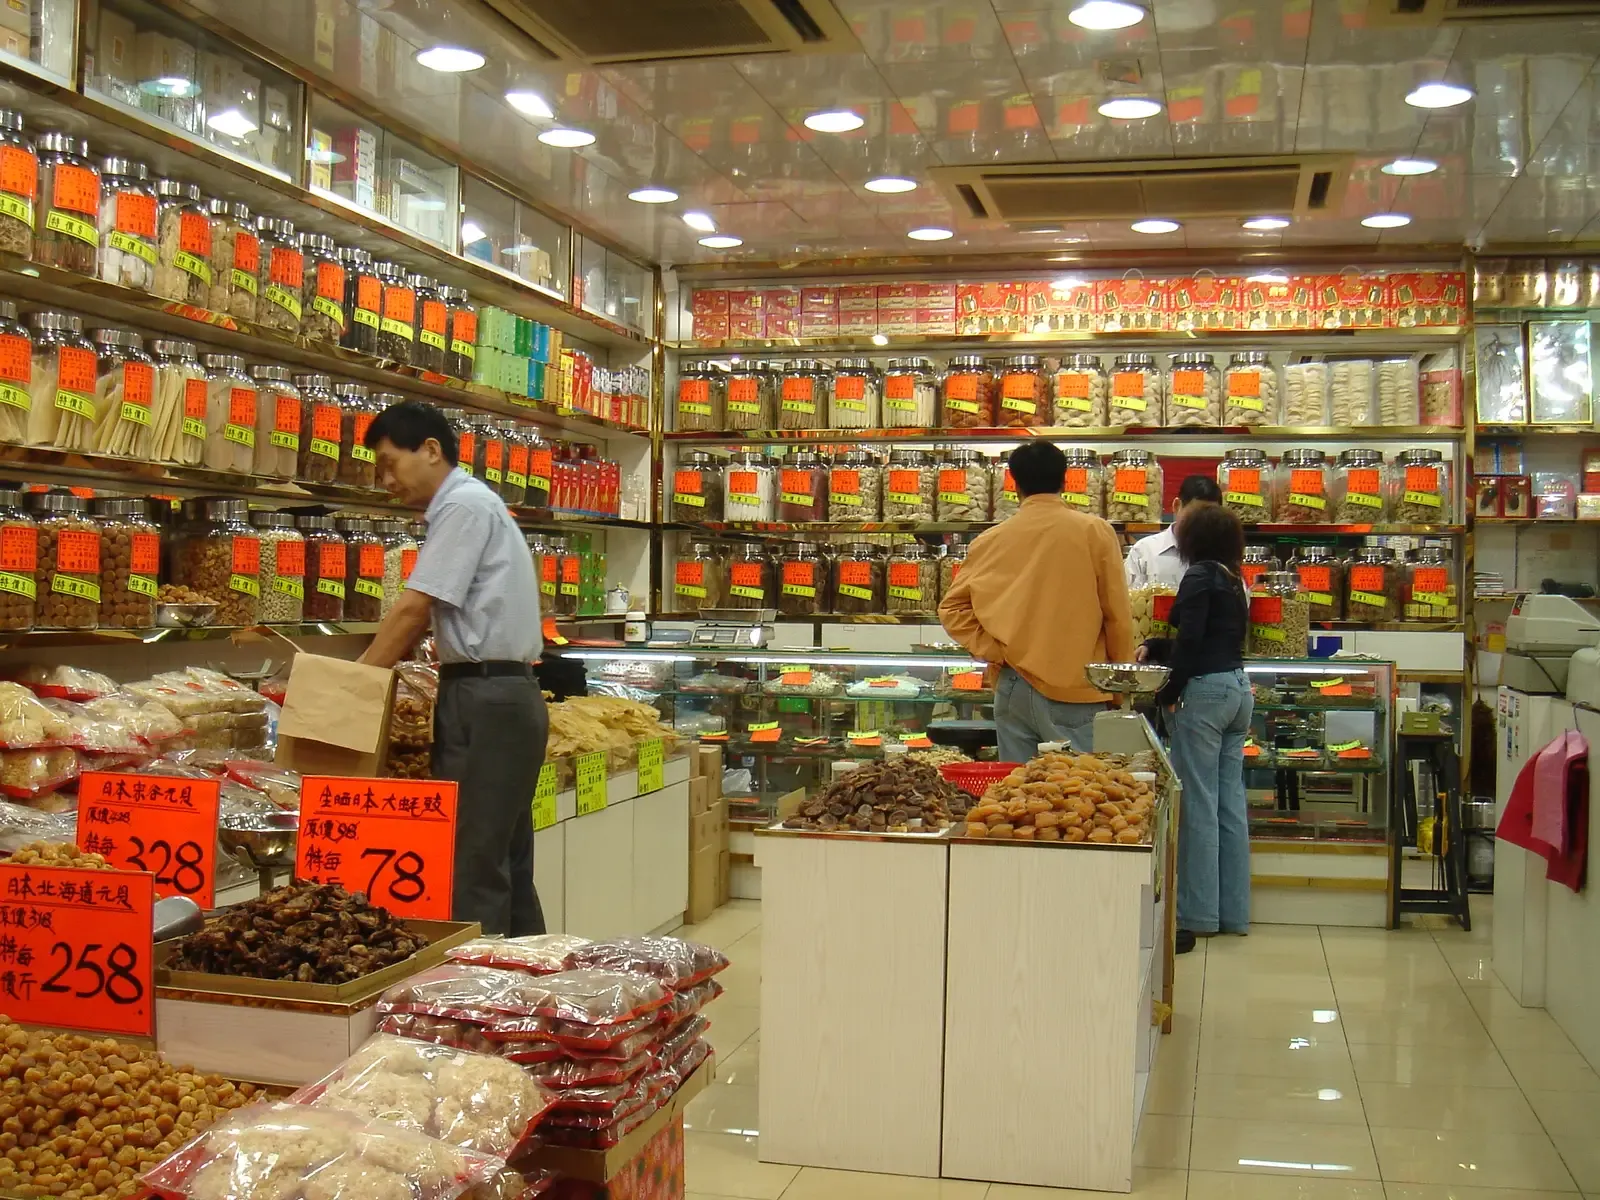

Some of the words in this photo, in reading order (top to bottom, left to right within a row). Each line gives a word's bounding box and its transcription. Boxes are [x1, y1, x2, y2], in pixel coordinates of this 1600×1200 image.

[8, 872, 133, 910] 日本北海道元貝
